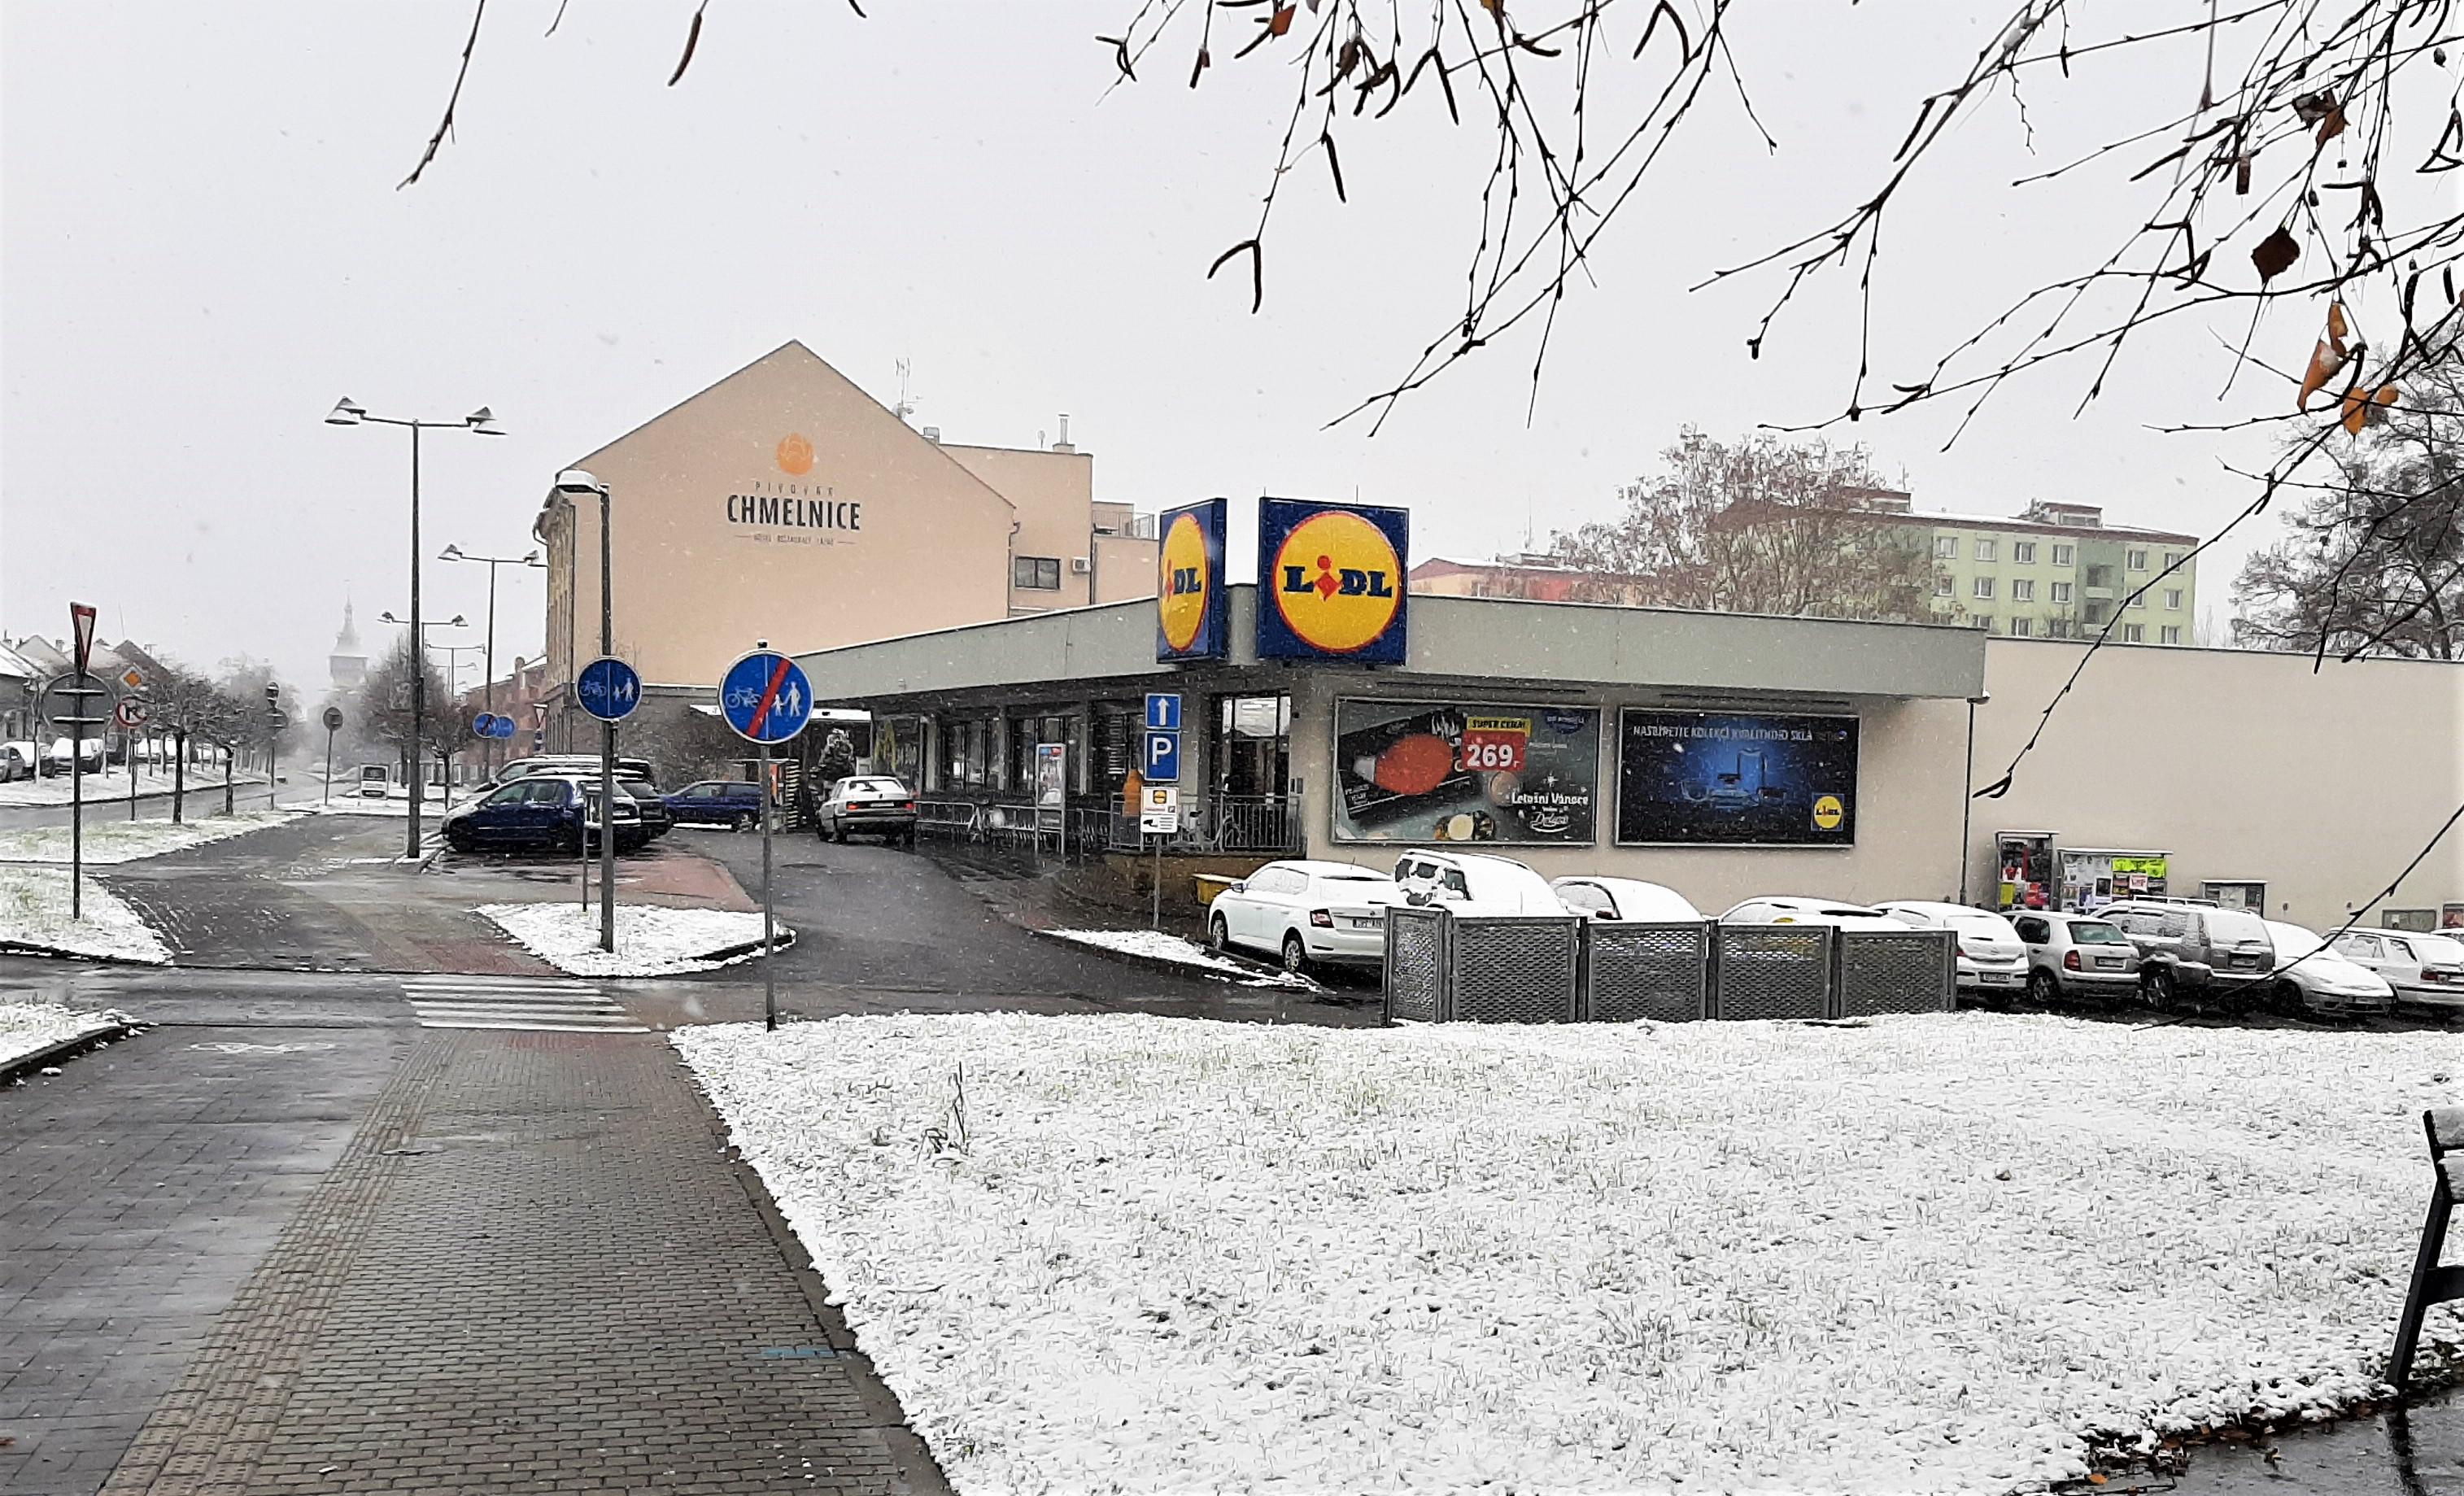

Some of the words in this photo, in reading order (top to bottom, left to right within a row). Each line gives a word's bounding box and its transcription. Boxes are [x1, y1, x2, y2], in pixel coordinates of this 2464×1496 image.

[755, 481, 834, 496] PIVOVAR
[726, 495, 861, 530] CHMELNICE
[1790, 730, 1813, 741] SKLA
[1152, 737, 1172, 765] P
